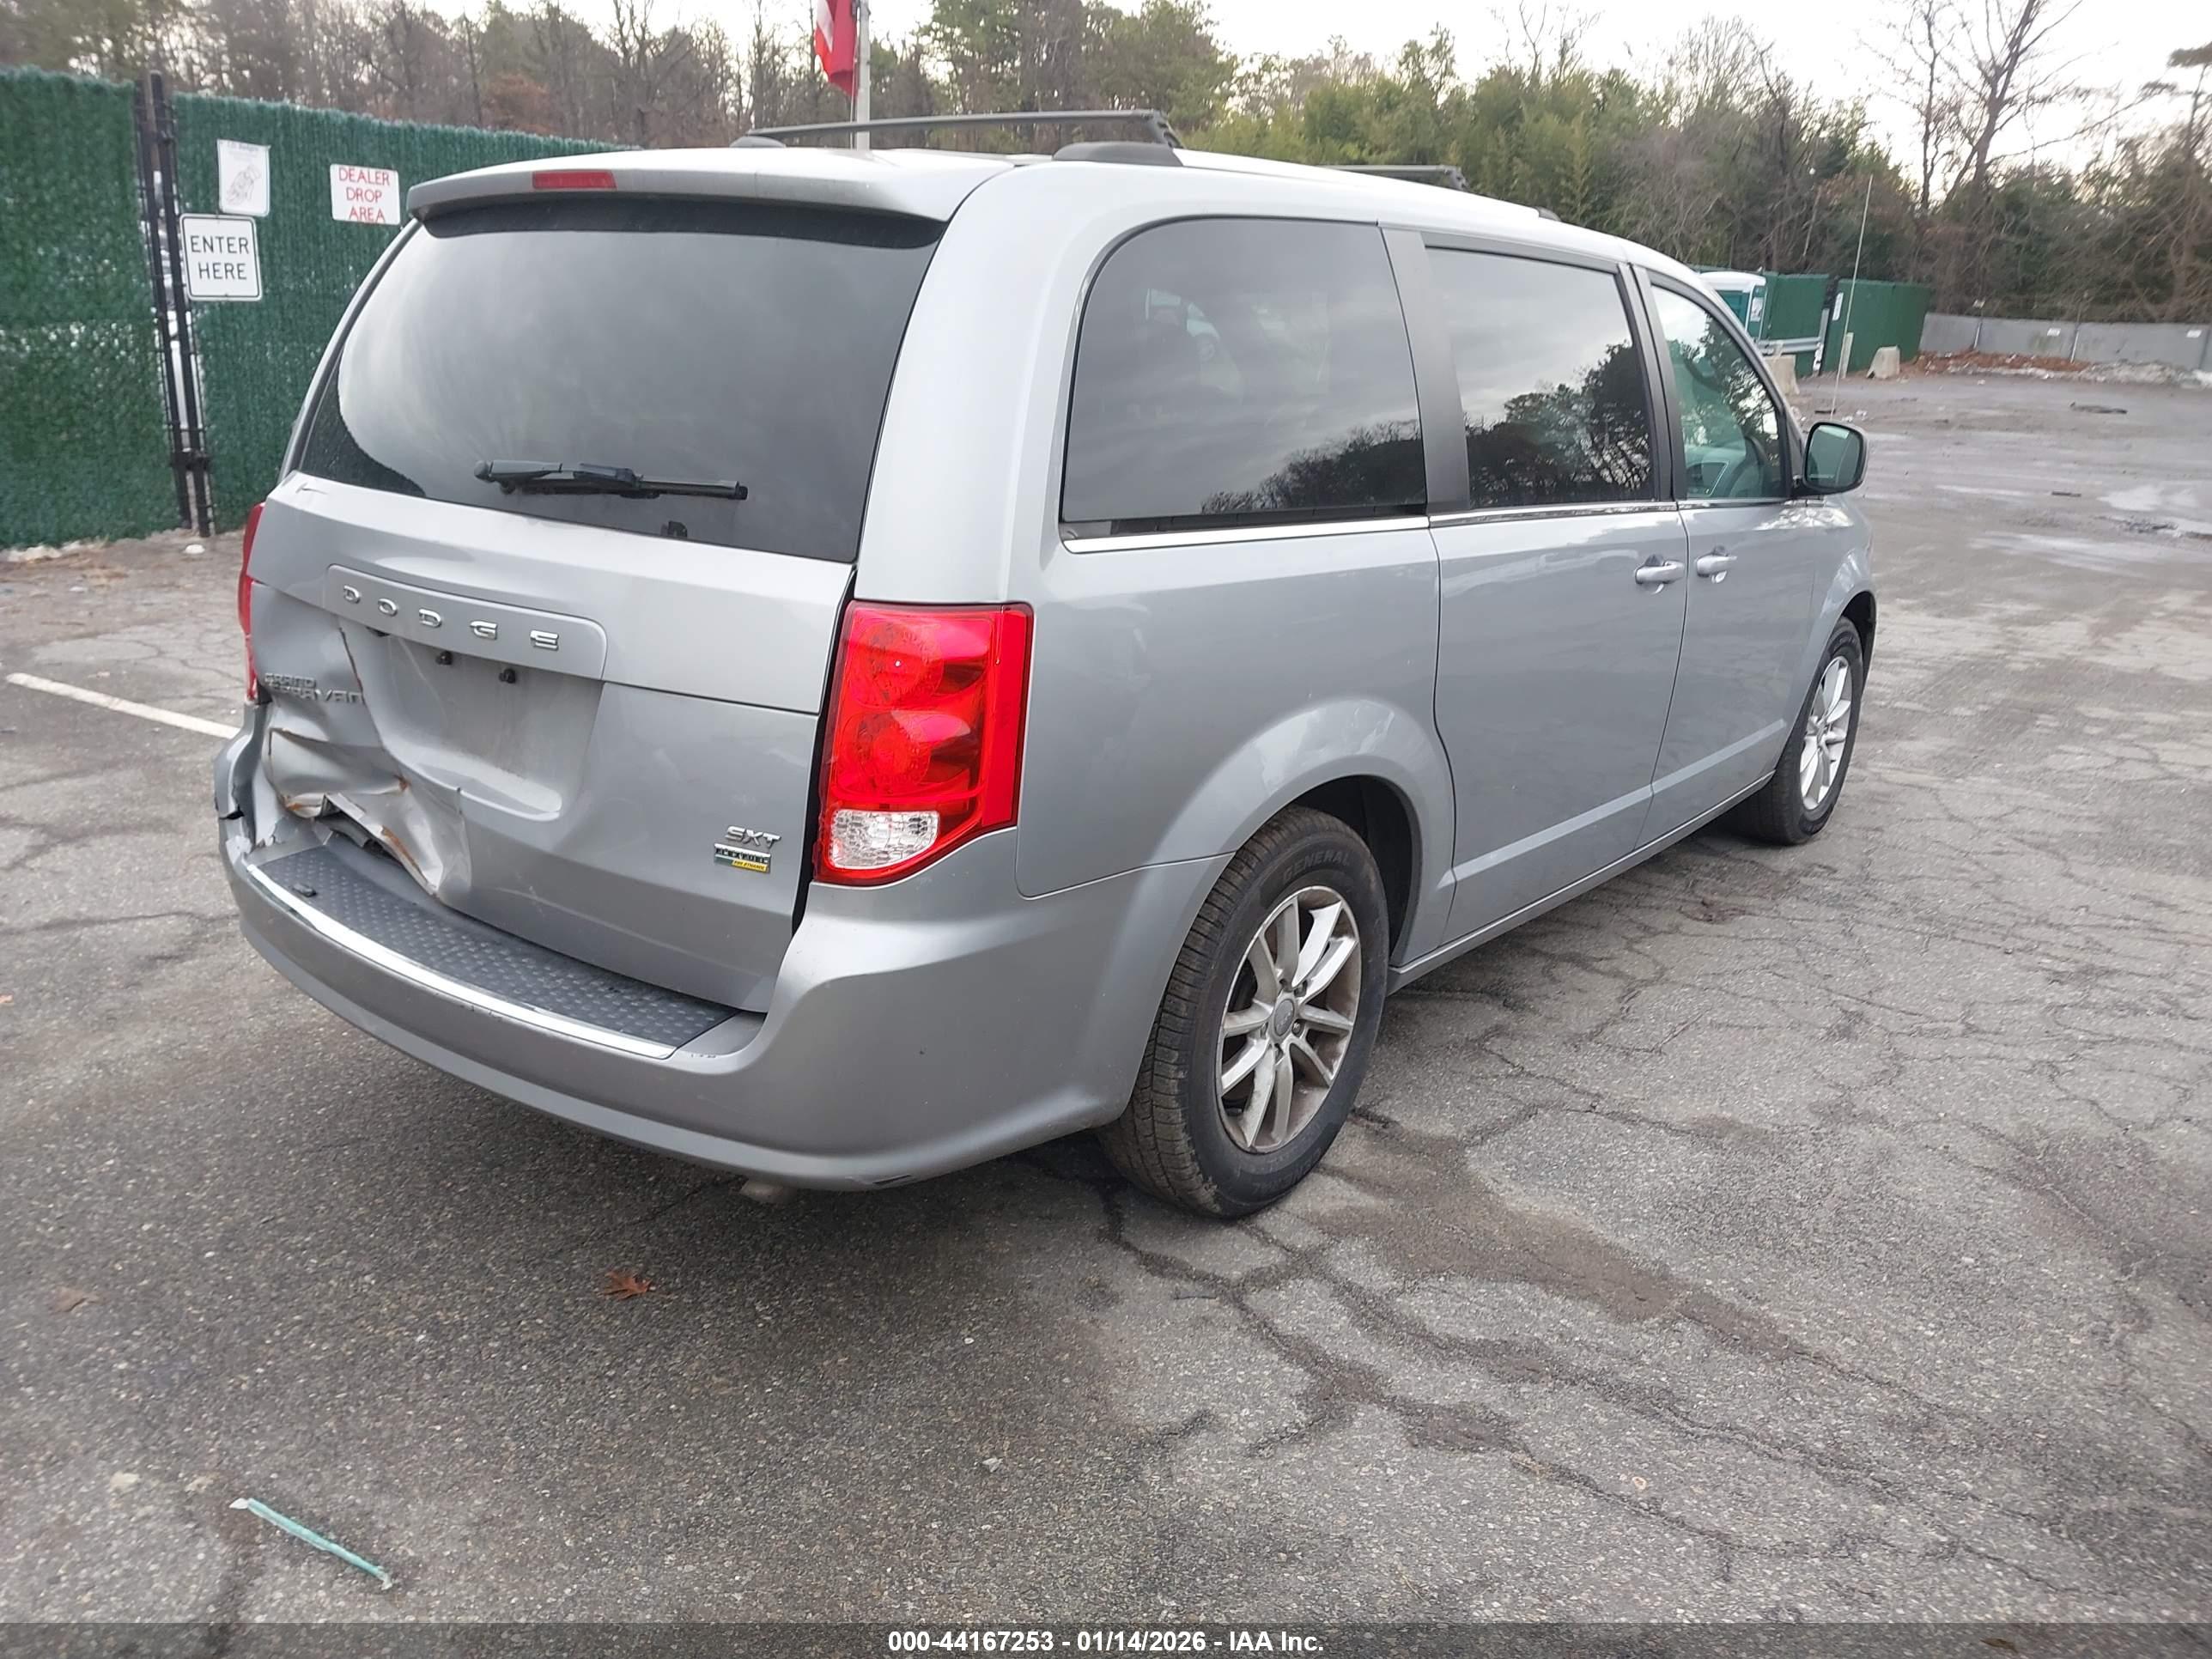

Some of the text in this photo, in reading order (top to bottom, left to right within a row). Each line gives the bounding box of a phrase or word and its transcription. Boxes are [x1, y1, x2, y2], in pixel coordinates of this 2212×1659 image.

[338, 167, 391, 186] DEALER
[346, 187, 383, 204] DROP
[349, 205, 386, 224] AREA
[191, 235, 250, 255] ENTER
[198, 262, 247, 280] HERE
[343, 584, 560, 651] DODGE
[725, 825, 782, 848] SXT
